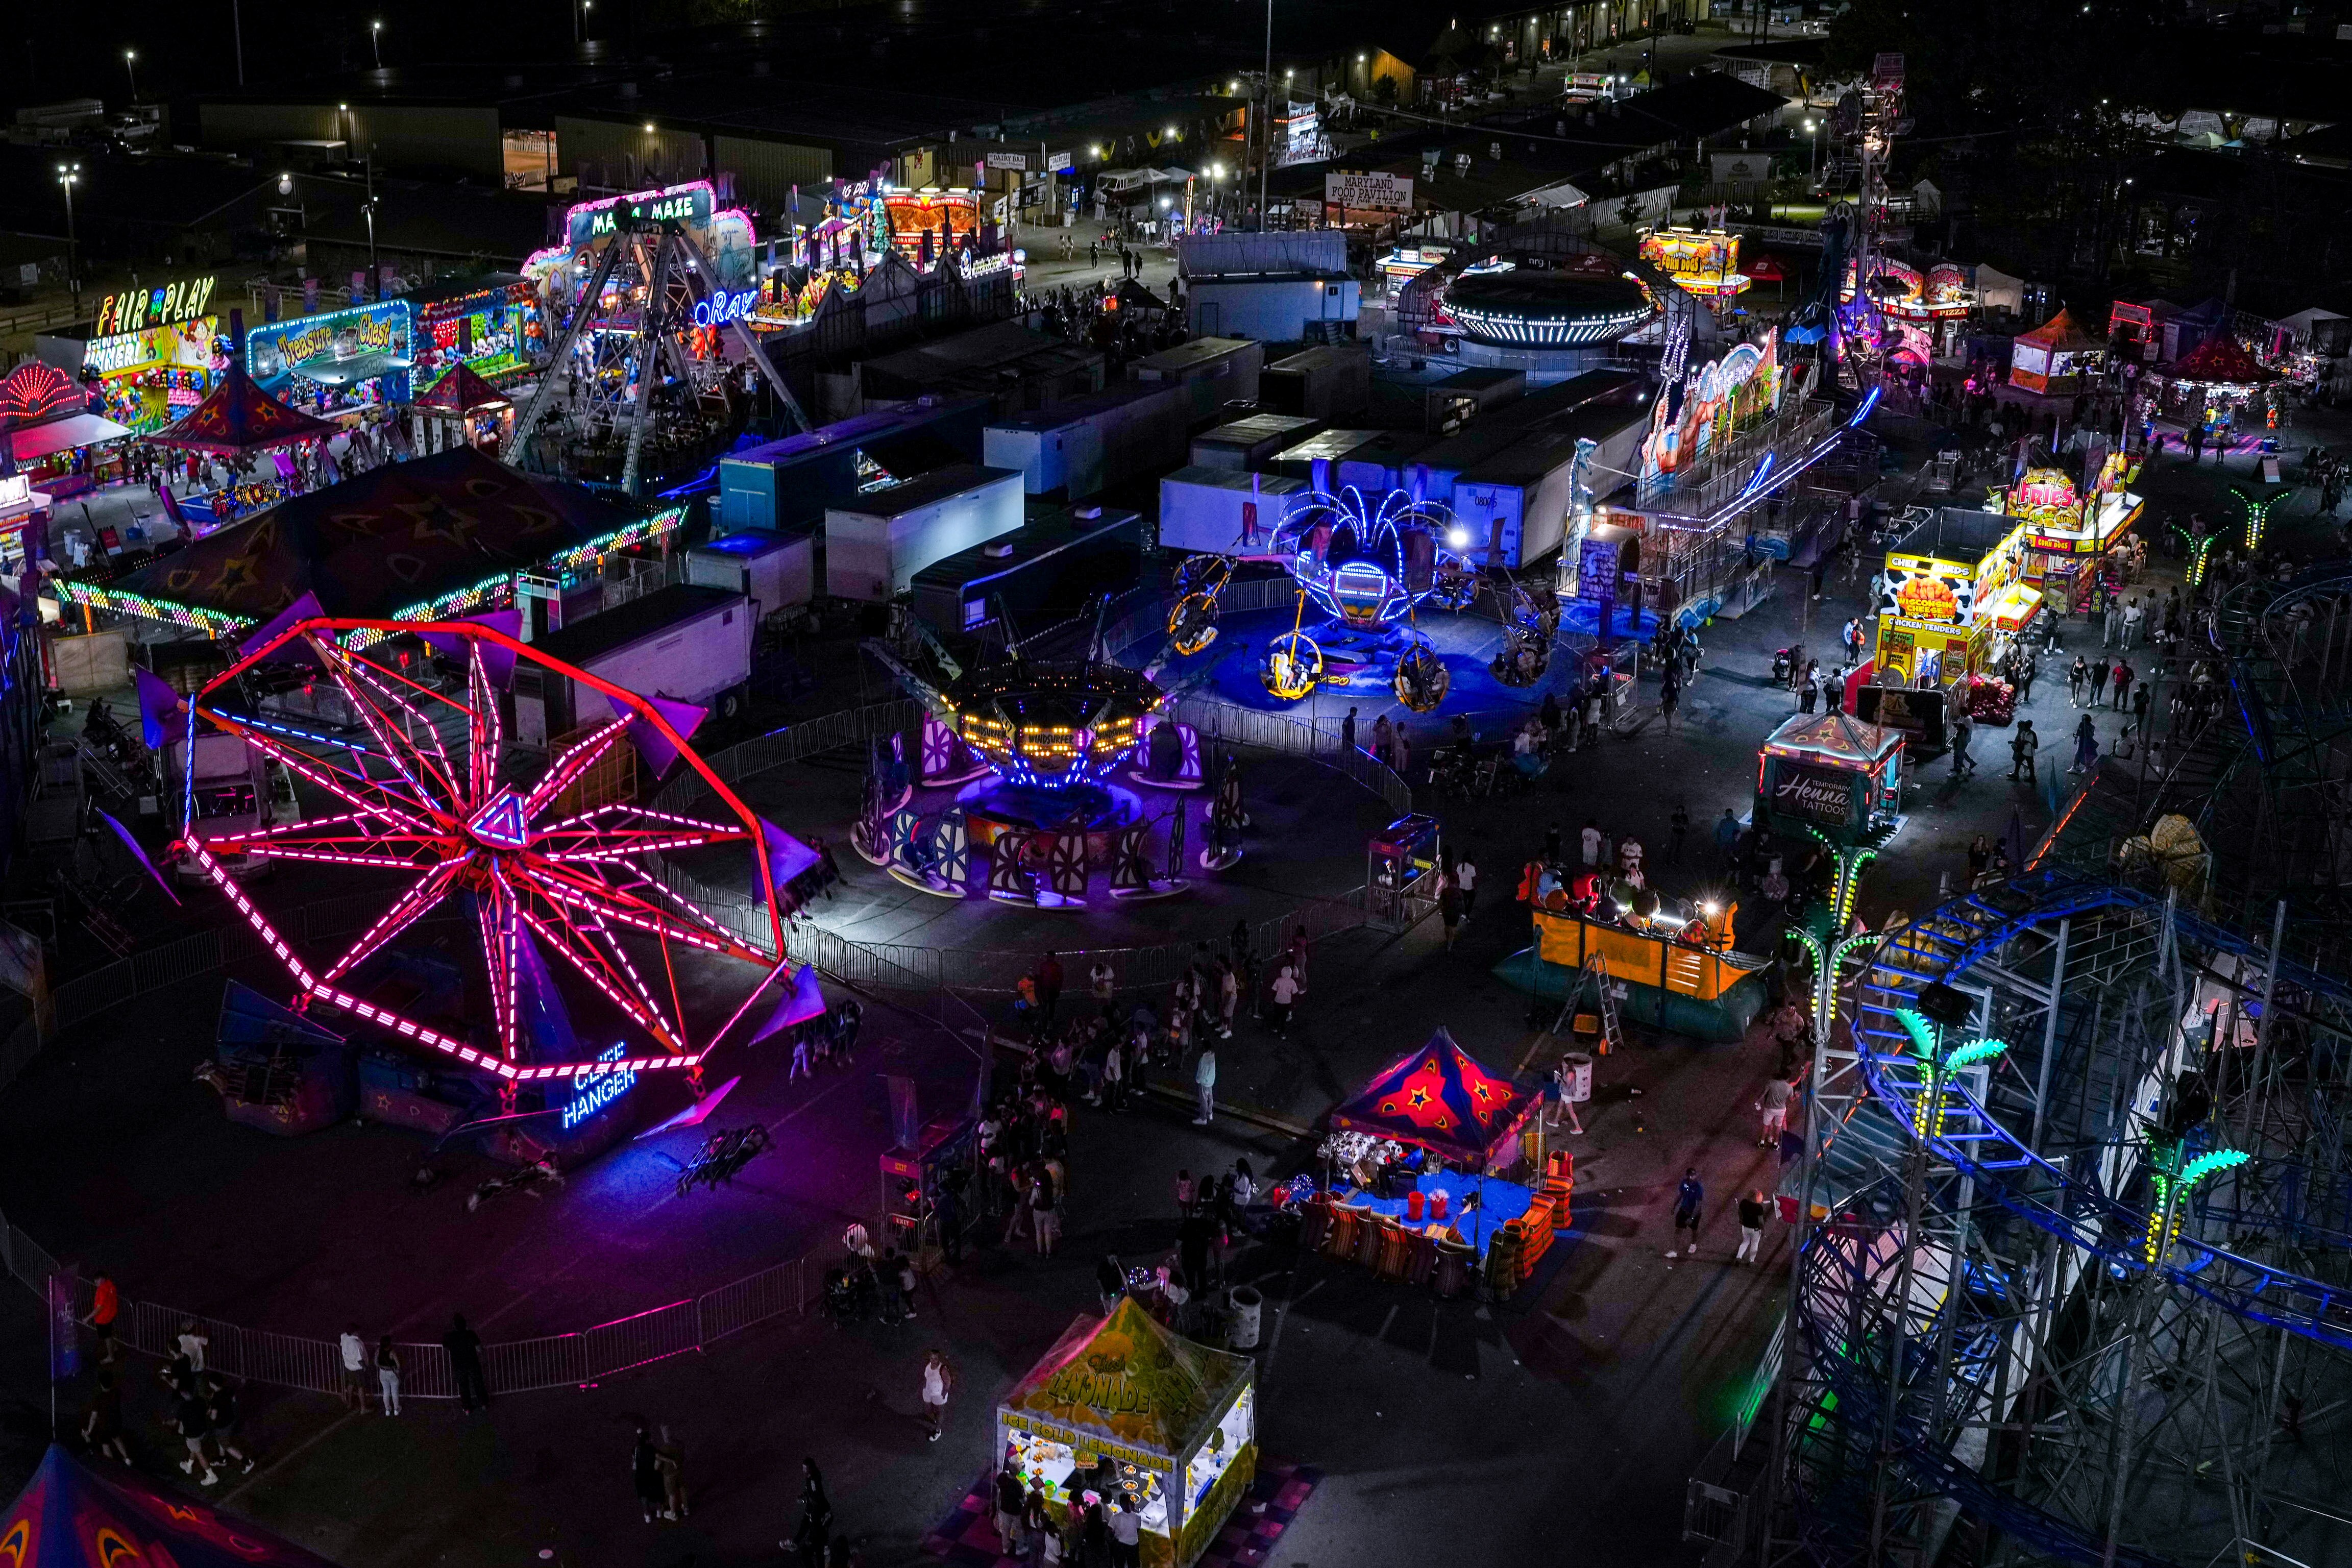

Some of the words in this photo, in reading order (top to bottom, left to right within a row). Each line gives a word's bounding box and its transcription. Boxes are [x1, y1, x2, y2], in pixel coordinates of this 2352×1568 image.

[1345, 177, 1393, 189] MARYLAND
[1332, 186, 1355, 197] FOOD
[1359, 188, 1407, 201] PAVILION
[651, 197, 693, 221] MAZE
[908, 199, 921, 207] STICK
[929, 199, 954, 207] RIBBON
[956, 199, 975, 207] FRIES
[1673, 251, 1689, 259] JUMBO
[1529, 257, 1545, 266] nrg
[1681, 256, 1700, 272] DOGS
[1892, 259, 1911, 272] BAKED
[1925, 269, 1961, 292] PIZZA
[97, 288, 148, 337] FAIR
[161, 276, 214, 324] PLAY
[1940, 308, 1966, 316] PIZZA
[277, 324, 334, 370] Treasure
[358, 312, 392, 349] Chest
[2058, 479, 2070, 489] CITY
[2018, 477, 2074, 509] FRIES
[2010, 509, 2018, 518] CORN
[2019, 510, 2029, 519] DOGS
[2031, 511, 2055, 523] Lemonade
[2056, 515, 2077, 526] NACHOS
[2038, 539, 2052, 548] CORN
[2053, 540, 2068, 549] DOGS
[2044, 579, 2067, 588] Lemonade
[1897, 598, 1953, 608] WISCONSIN
[2091, 591, 2102, 612] ATM
[1906, 605, 1943, 614] CHEESE
[1888, 618, 1922, 629] CHICKEN
[1924, 623, 1962, 636] TENDERS
[1028, 734, 1074, 744] WINDSURFER
[1775, 773, 1851, 806] Henna
[1812, 779, 1851, 792] TEMPORARY
[1802, 799, 1846, 816] TATTOOS
[563, 1068, 634, 1129] HANGER
[895, 1162, 907, 1172] EXIT
[896, 1217, 910, 1227] EXIT
[1088, 1354, 1126, 1373] Fresh
[1047, 1373, 1152, 1414] LEMONADE
[1002, 1412, 1028, 1430] ICE
[1031, 1420, 1076, 1444] COLD
[1079, 1434, 1173, 1473] LEMONADE
